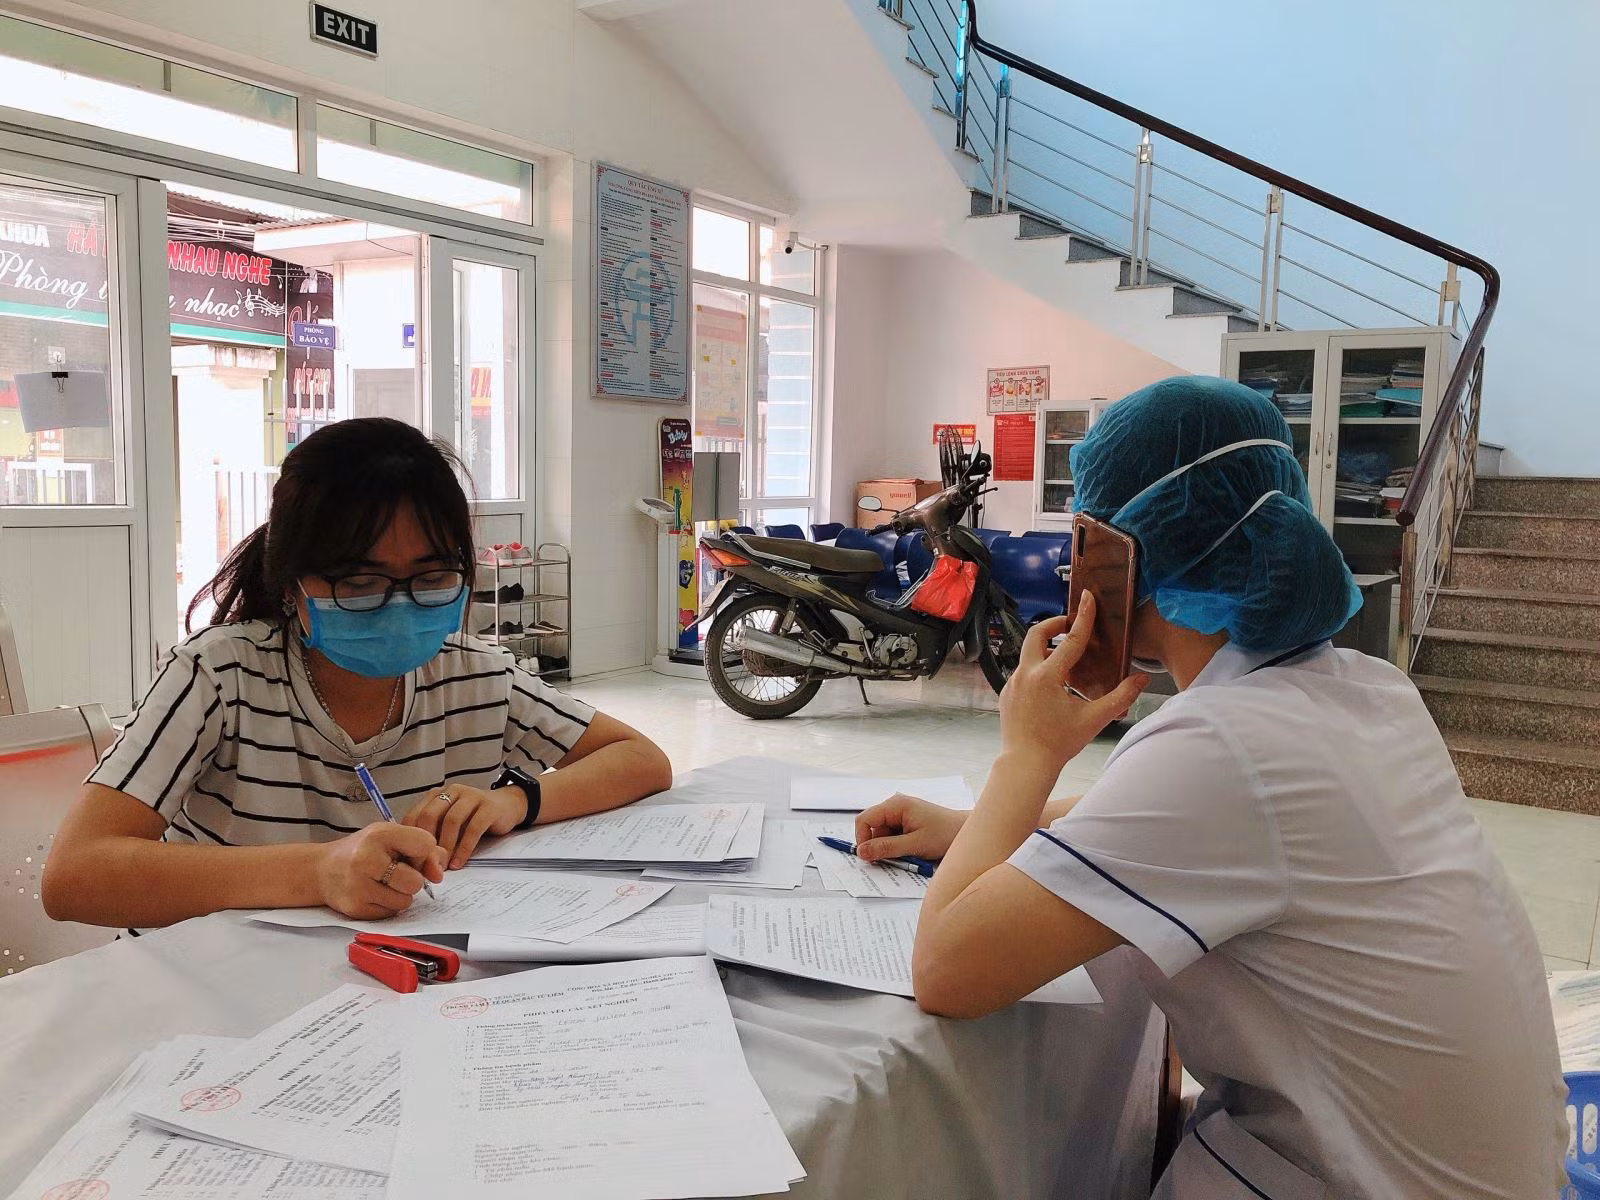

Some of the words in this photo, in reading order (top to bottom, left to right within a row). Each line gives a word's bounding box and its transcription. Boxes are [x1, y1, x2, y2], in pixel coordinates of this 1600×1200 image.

[323, 11, 369, 45] EXIT
[0, 249, 88, 309] Phòng
[168, 240, 219, 276] NHAU
[222, 251, 272, 286] NGHE
[184, 288, 240, 321] nhạc
[299, 334, 317, 344] BẢO
[318, 337, 331, 346] VỆ
[303, 326, 325, 335] PHÒNG
